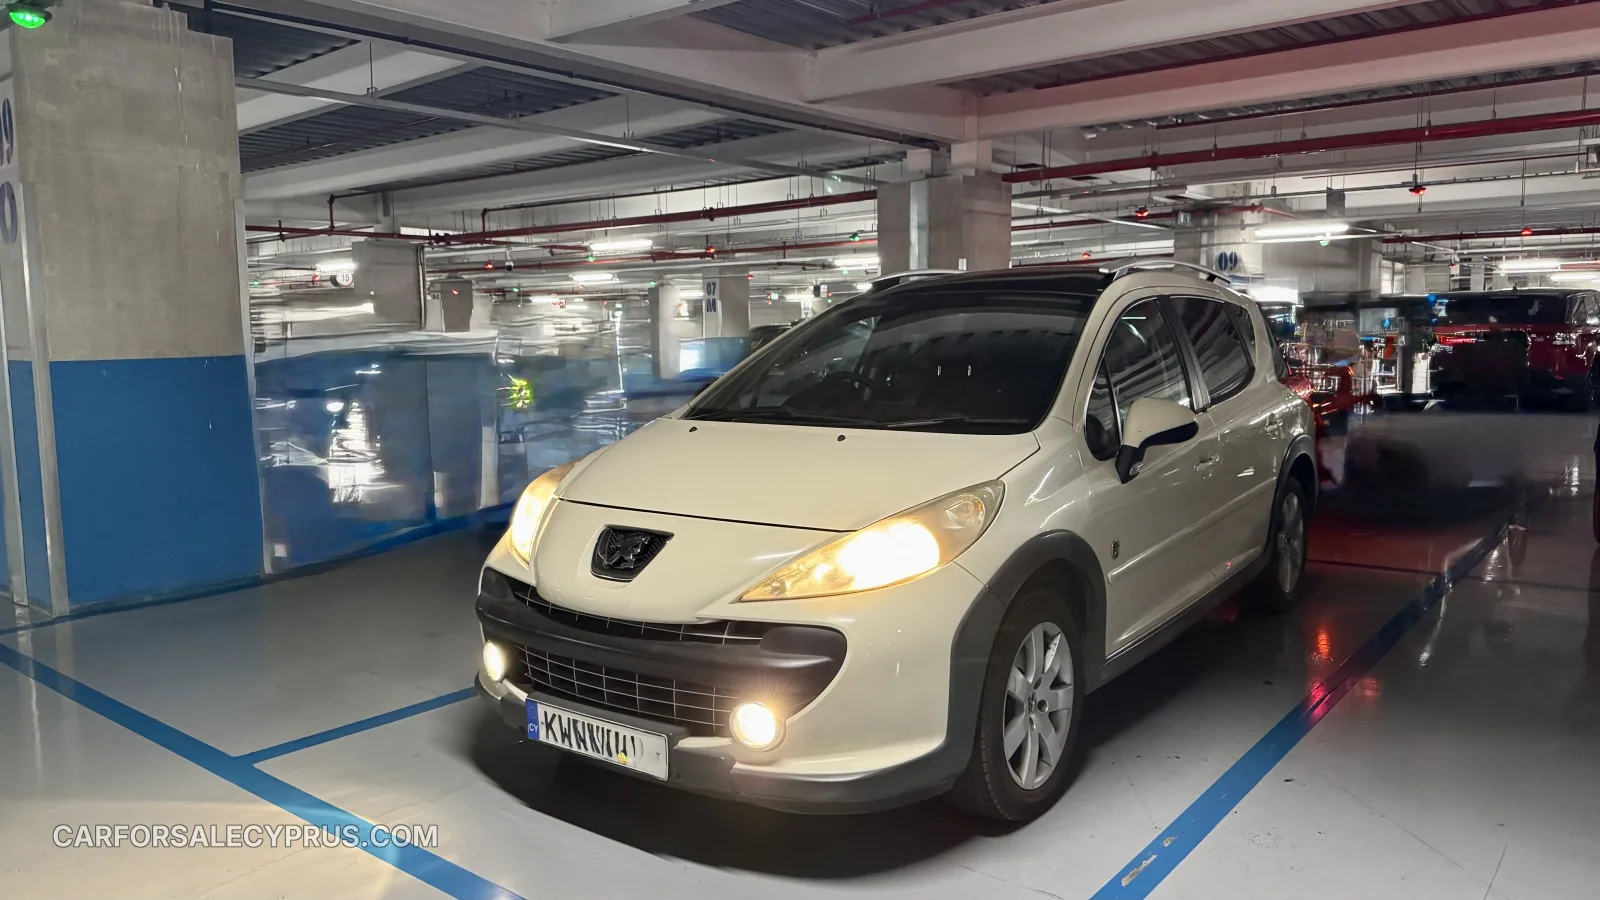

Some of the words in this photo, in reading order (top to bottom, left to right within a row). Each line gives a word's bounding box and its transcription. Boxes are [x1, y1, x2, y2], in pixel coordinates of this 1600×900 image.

[1218, 251, 1238, 271] 09
[341, 273, 350, 282] 15
[706, 281, 717, 296] 07
